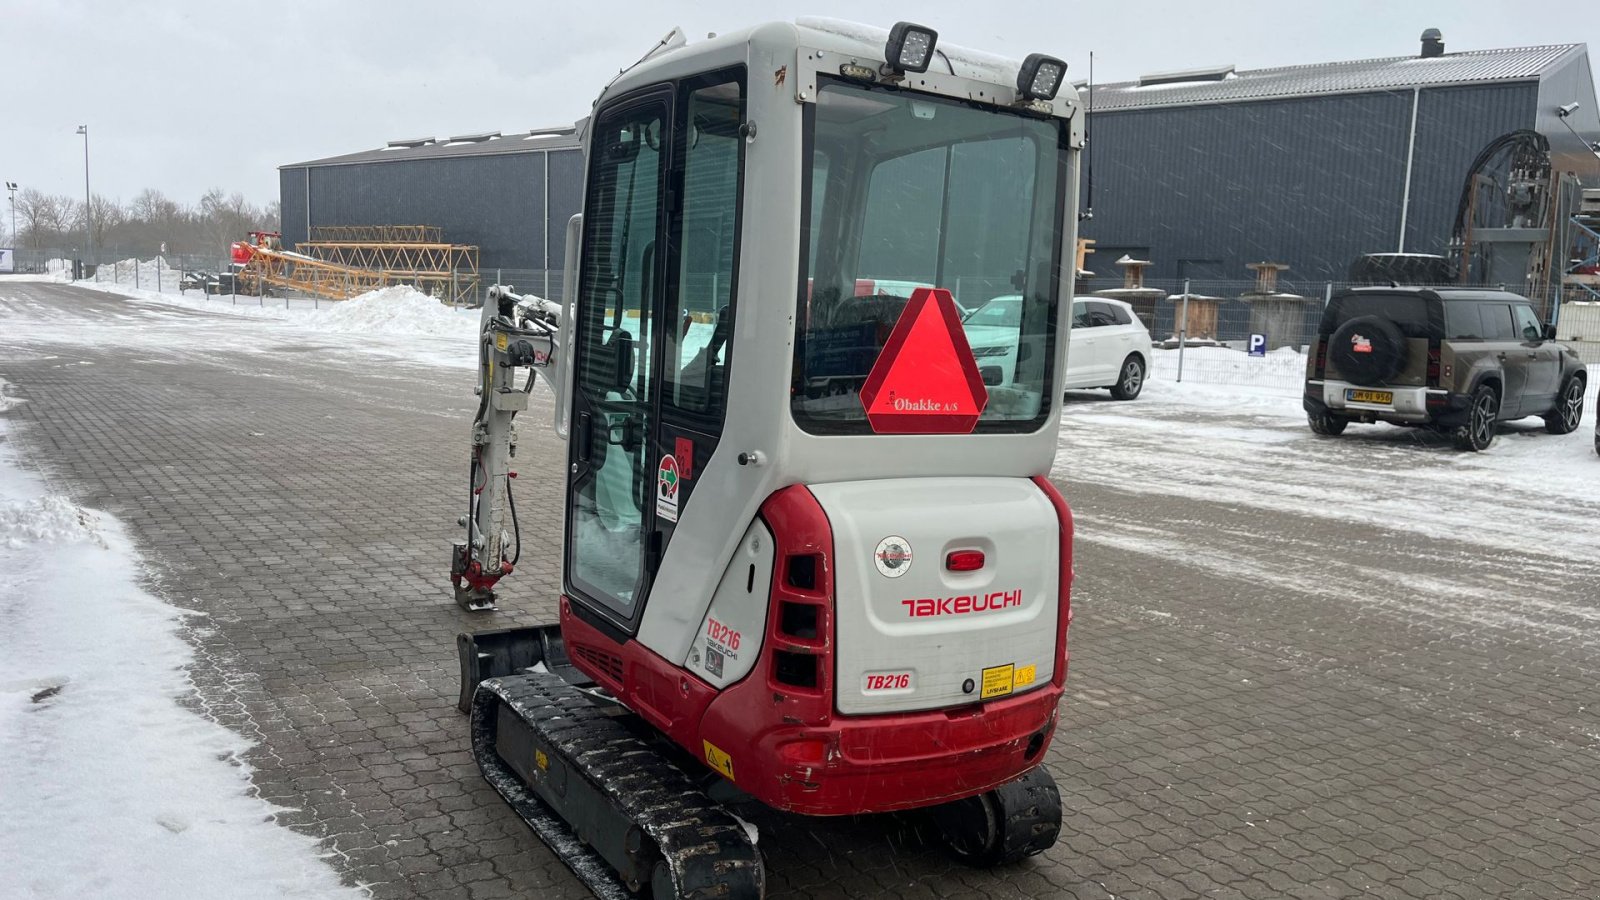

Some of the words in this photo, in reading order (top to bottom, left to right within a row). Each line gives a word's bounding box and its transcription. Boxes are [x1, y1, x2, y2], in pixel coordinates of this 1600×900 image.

[1250, 334, 1265, 351] P
[894, 397, 941, 411] Øbakke
[943, 402, 958, 411] A/S
[707, 618, 741, 651] TB216
[866, 674, 910, 690] TB216
